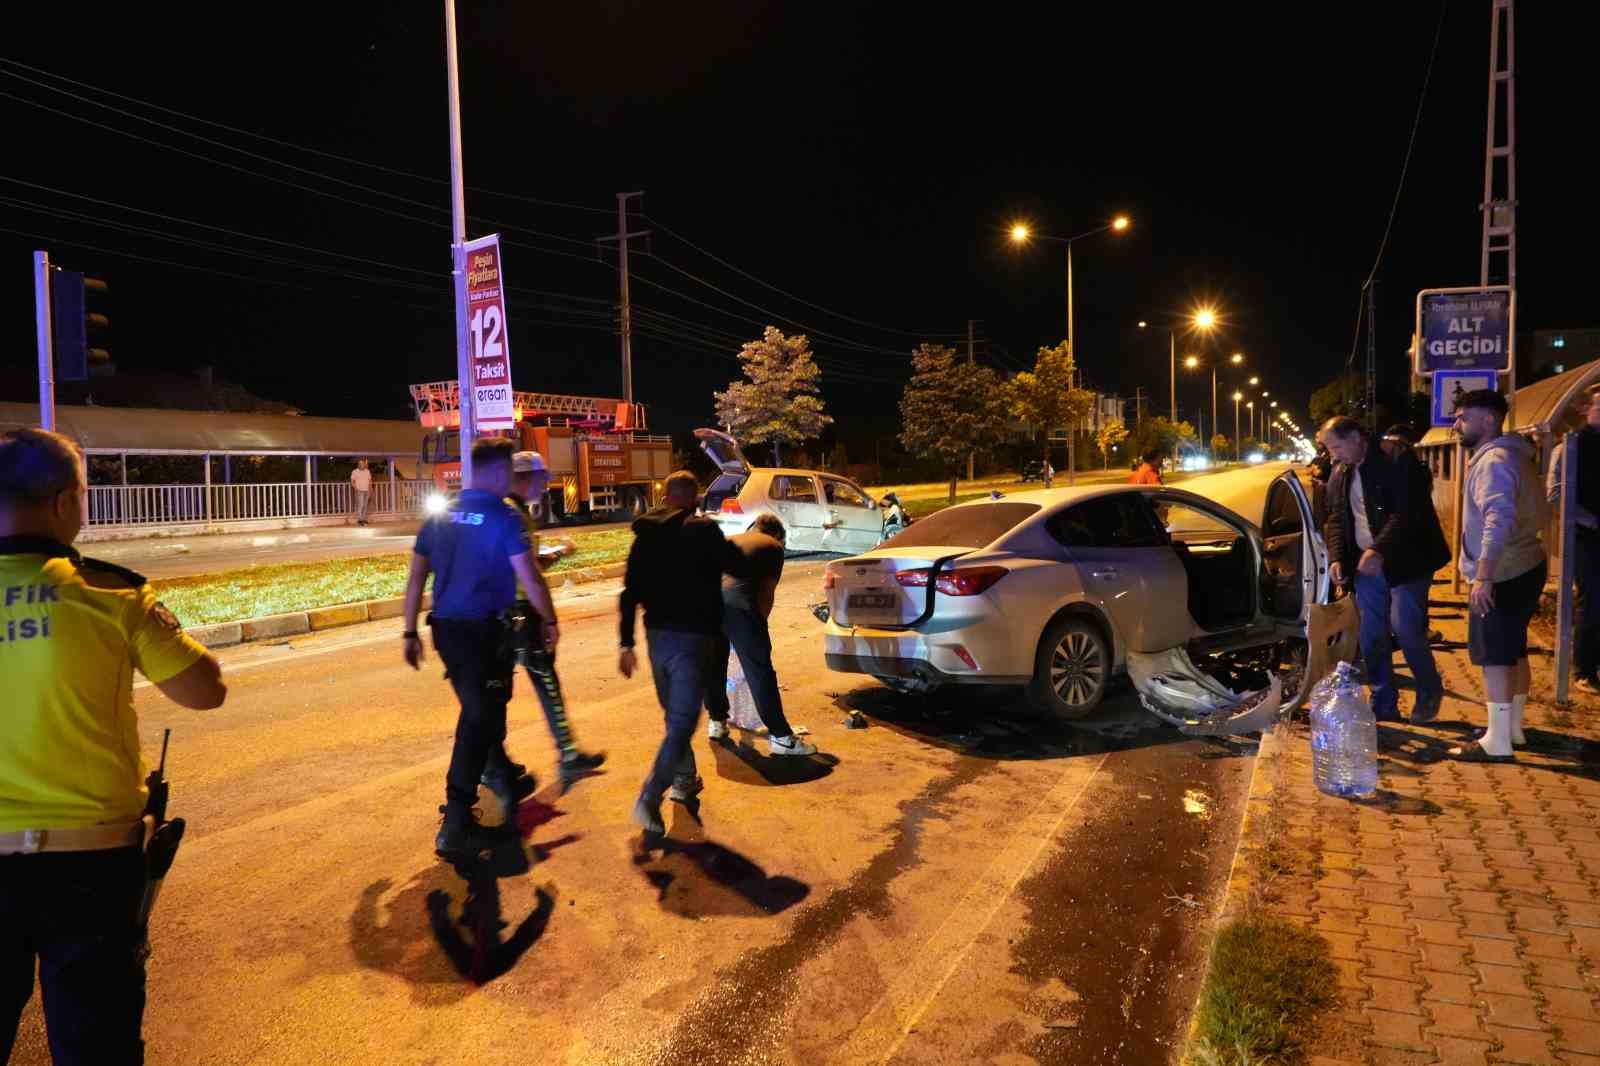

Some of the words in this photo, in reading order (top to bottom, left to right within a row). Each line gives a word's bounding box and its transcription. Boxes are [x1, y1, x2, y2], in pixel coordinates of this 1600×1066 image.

[471, 305, 503, 357] 12
[1448, 317, 1484, 334] ALT
[475, 361, 505, 379] Taksit
